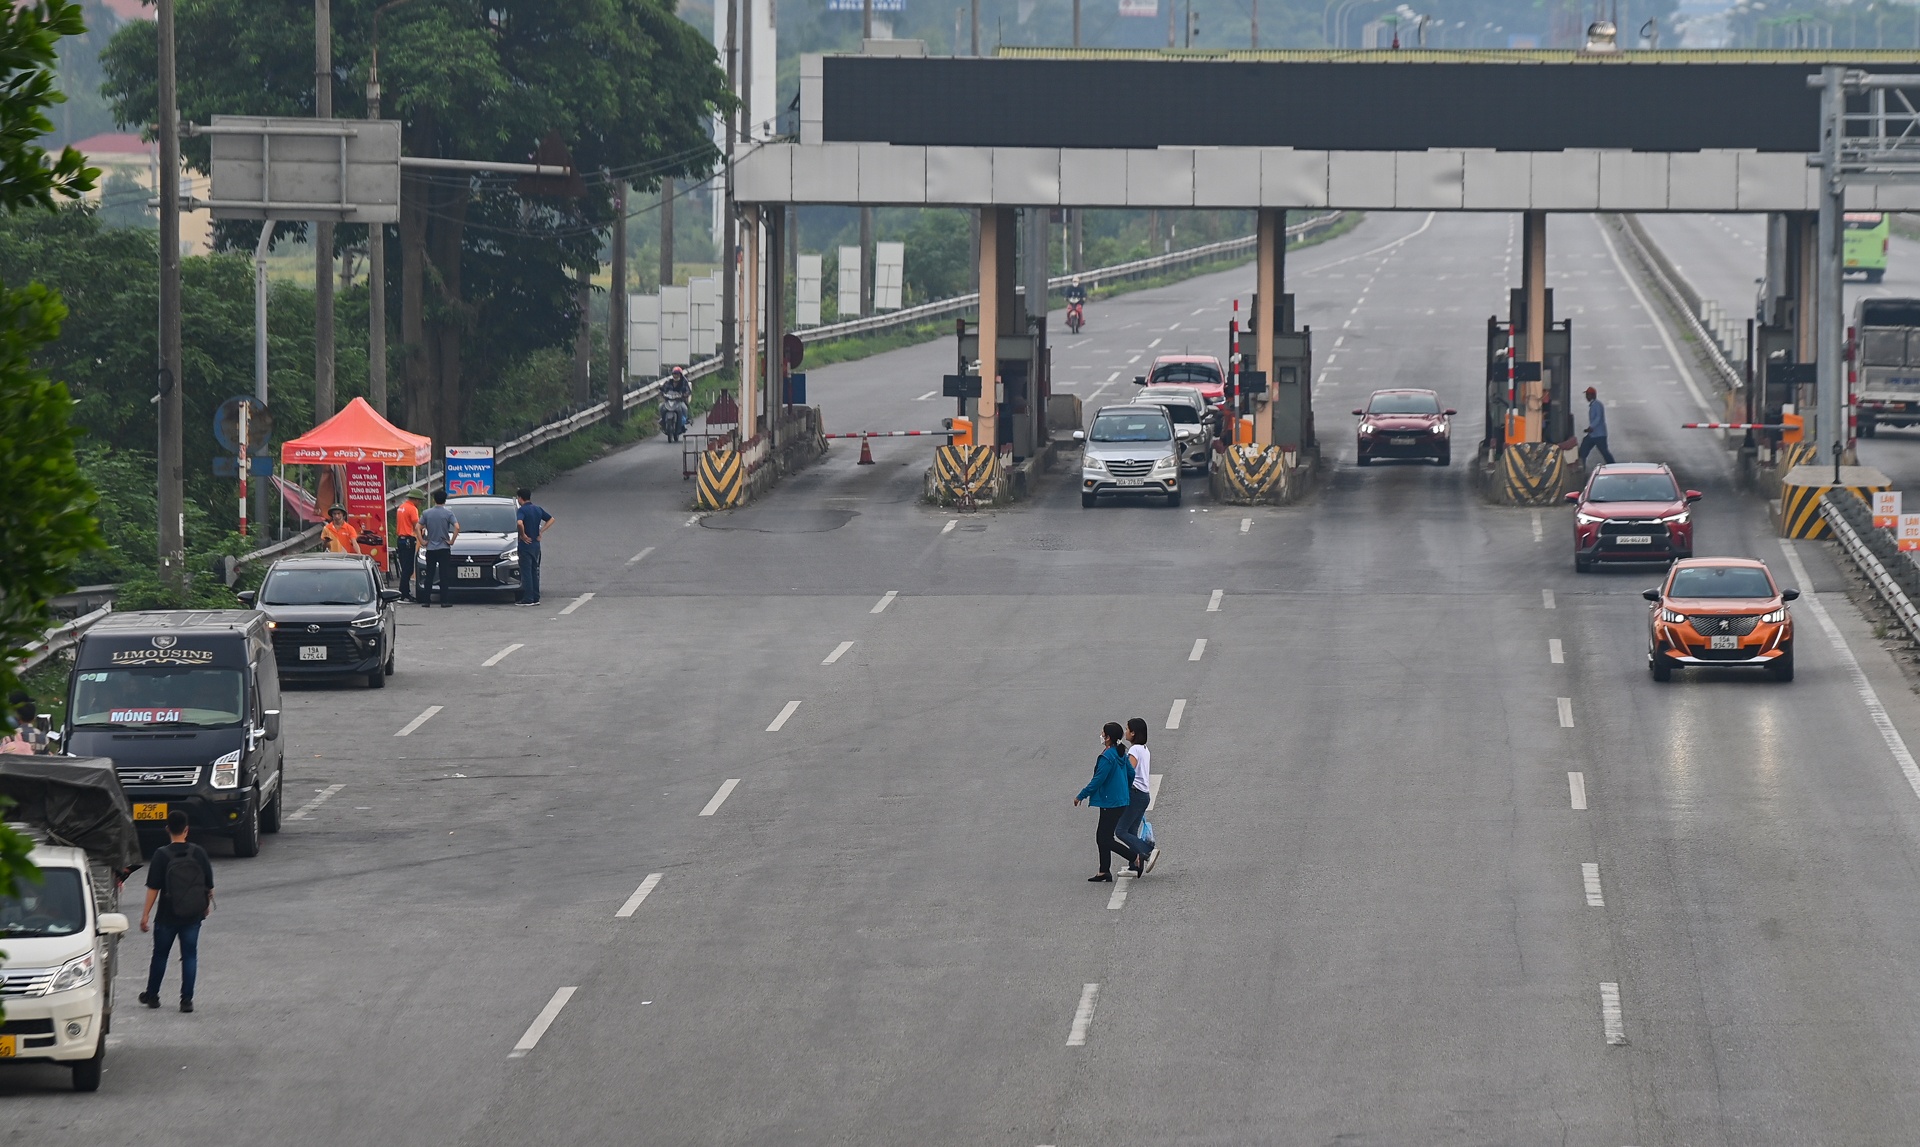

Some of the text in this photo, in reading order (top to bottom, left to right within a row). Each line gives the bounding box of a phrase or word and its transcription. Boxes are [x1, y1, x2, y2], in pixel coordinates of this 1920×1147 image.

[295, 449, 320, 457] ePass
[333, 449, 359, 458] ePass
[372, 450, 397, 458] ePass
[449, 480, 490, 496] 50k
[1880, 505, 1894, 513] ETC
[1905, 528, 1919, 536] ETC
[112, 649, 213, 661] LIMOUSINE
[110, 709, 180, 722] MÓNG CÁI
